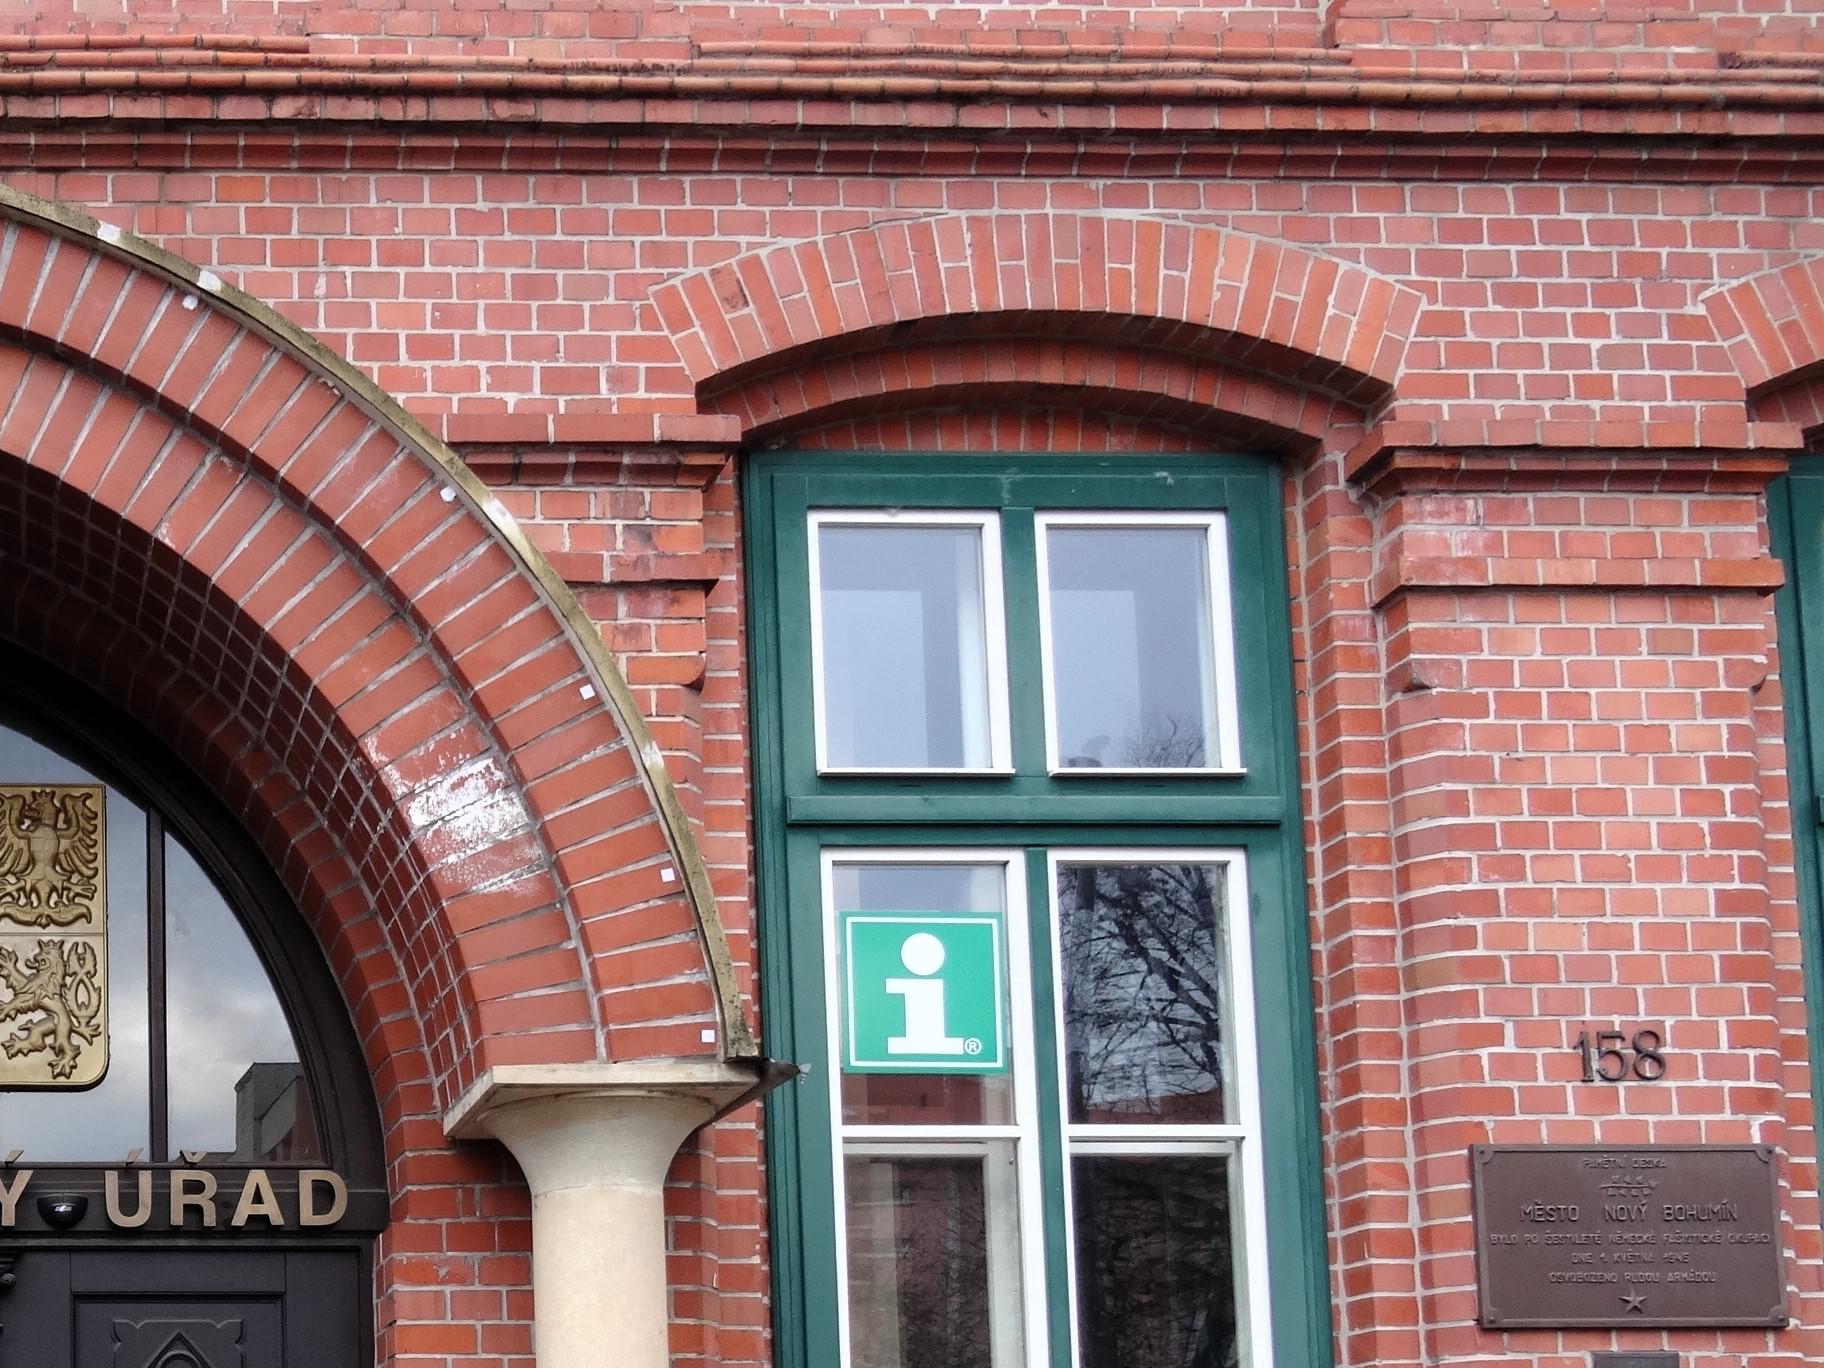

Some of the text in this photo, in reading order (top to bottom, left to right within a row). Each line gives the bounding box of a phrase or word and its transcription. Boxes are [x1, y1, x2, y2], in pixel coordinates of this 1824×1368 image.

[1573, 1029, 1666, 1083] 158
[104, 1147, 350, 1227] ÚŘAD
[1520, 1198, 1738, 1222] MĚSTO NOVÝ BOHUMÍN
[1490, 1233, 1519, 1245] BYLO
[1524, 1234, 1538, 1245] PO
